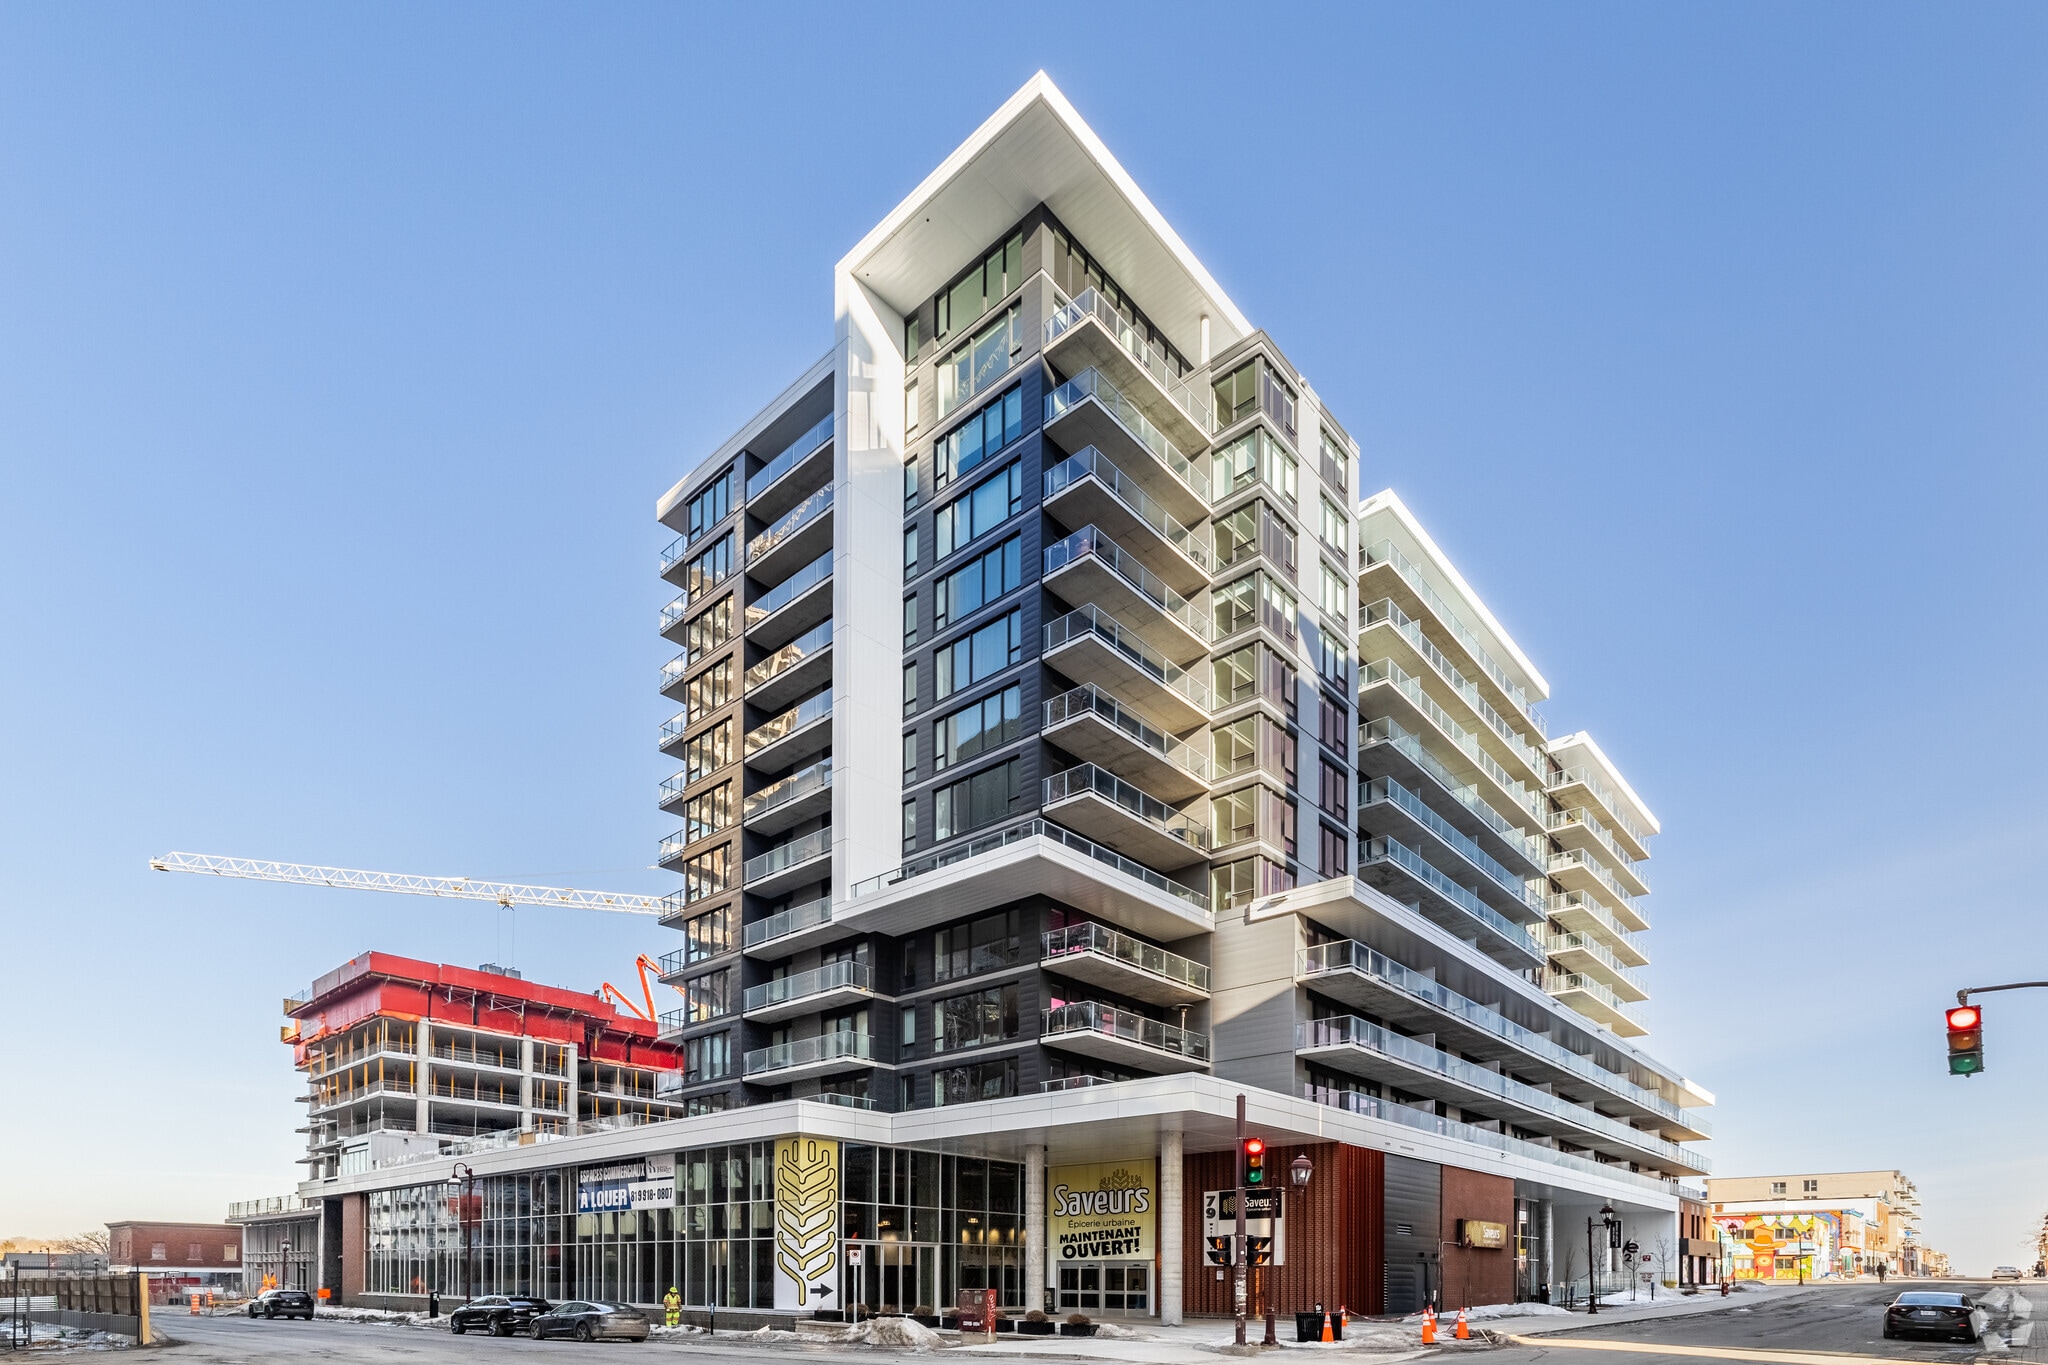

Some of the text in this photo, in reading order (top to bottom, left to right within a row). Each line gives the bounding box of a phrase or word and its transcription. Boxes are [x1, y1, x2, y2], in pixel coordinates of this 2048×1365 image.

[580, 1162, 646, 1183] ESPACES COMMERCIAUX
[580, 1188, 628, 1209] À LOUER
[631, 1190, 642, 1202] 819
[1054, 1184, 1150, 1217] Saveurs
[1068, 1218, 1136, 1229] Épicerie urbaine
[1060, 1226, 1141, 1244] MAINTENANT
[1062, 1238, 1140, 1259] OUVERT!
